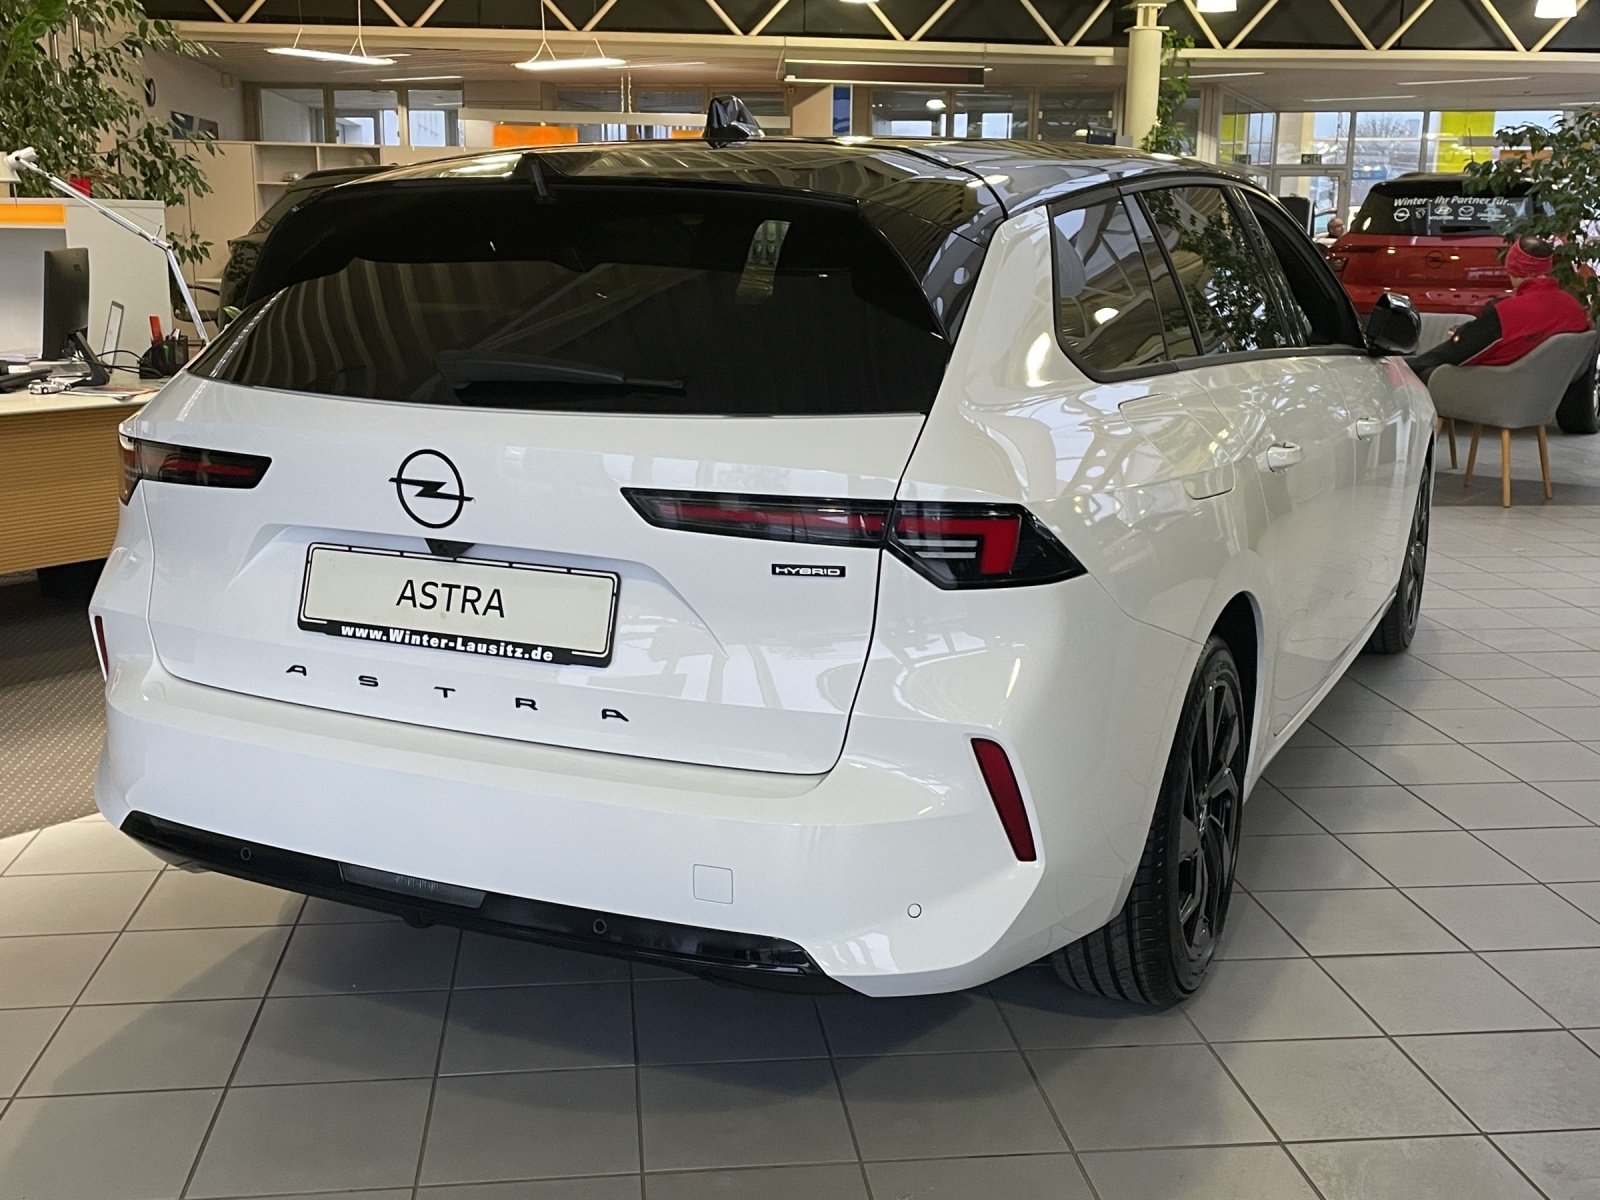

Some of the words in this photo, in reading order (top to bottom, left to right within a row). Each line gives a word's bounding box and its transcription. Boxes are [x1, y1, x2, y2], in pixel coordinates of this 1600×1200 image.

[1394, 197, 1427, 206] Winter
[1435, 195, 1451, 204] Ihr
[1451, 195, 1491, 205] Partner
[775, 566, 841, 576] HYBRID
[395, 579, 505, 619] ASTRA
[340, 624, 554, 662] www.Winter-Lausitz.de
[285, 664, 630, 723] ASTRA
